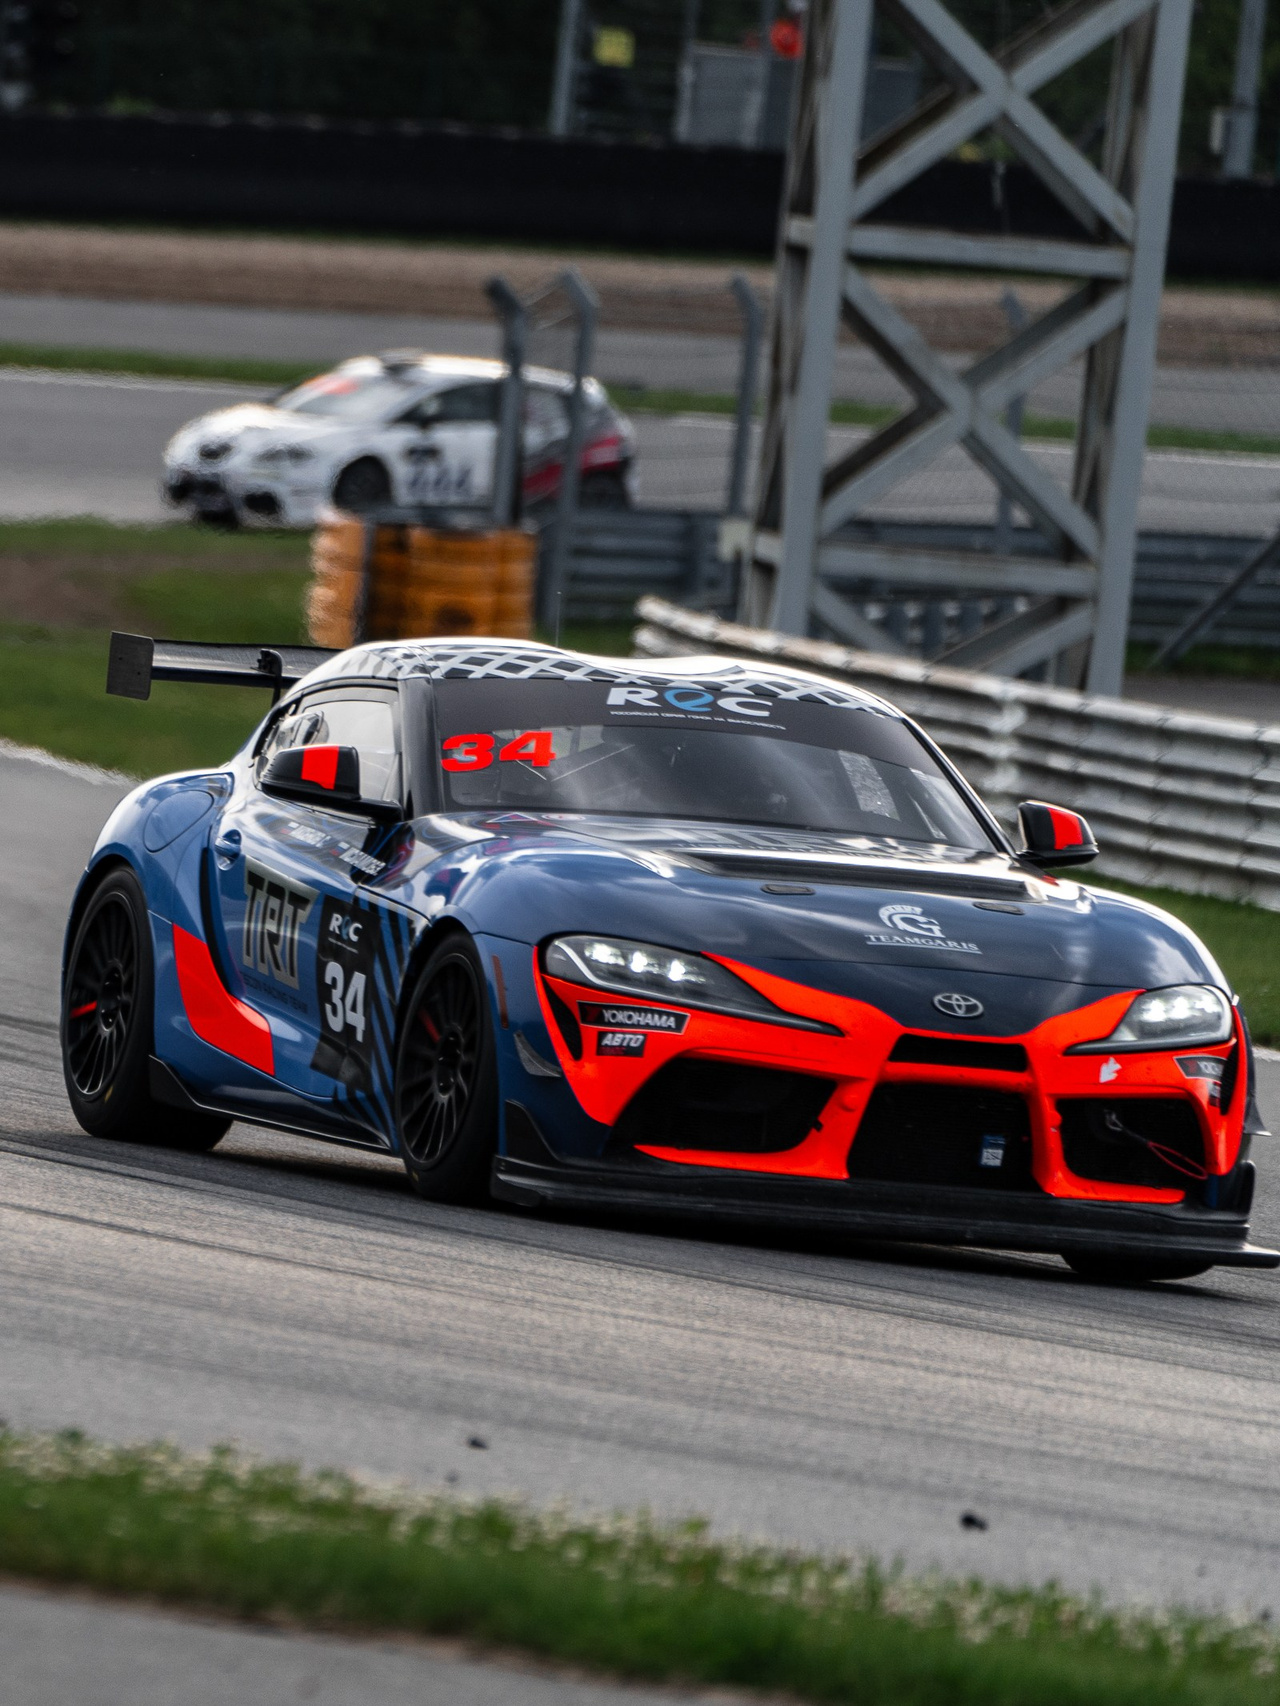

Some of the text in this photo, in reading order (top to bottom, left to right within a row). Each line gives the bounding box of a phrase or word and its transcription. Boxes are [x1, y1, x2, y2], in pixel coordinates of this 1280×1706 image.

[441, 730, 556, 773] 34
[864, 934, 980, 952] TEAMGARIS
[324, 961, 367, 1044] 34
[602, 1009, 676, 1029] YOKOHAMA
